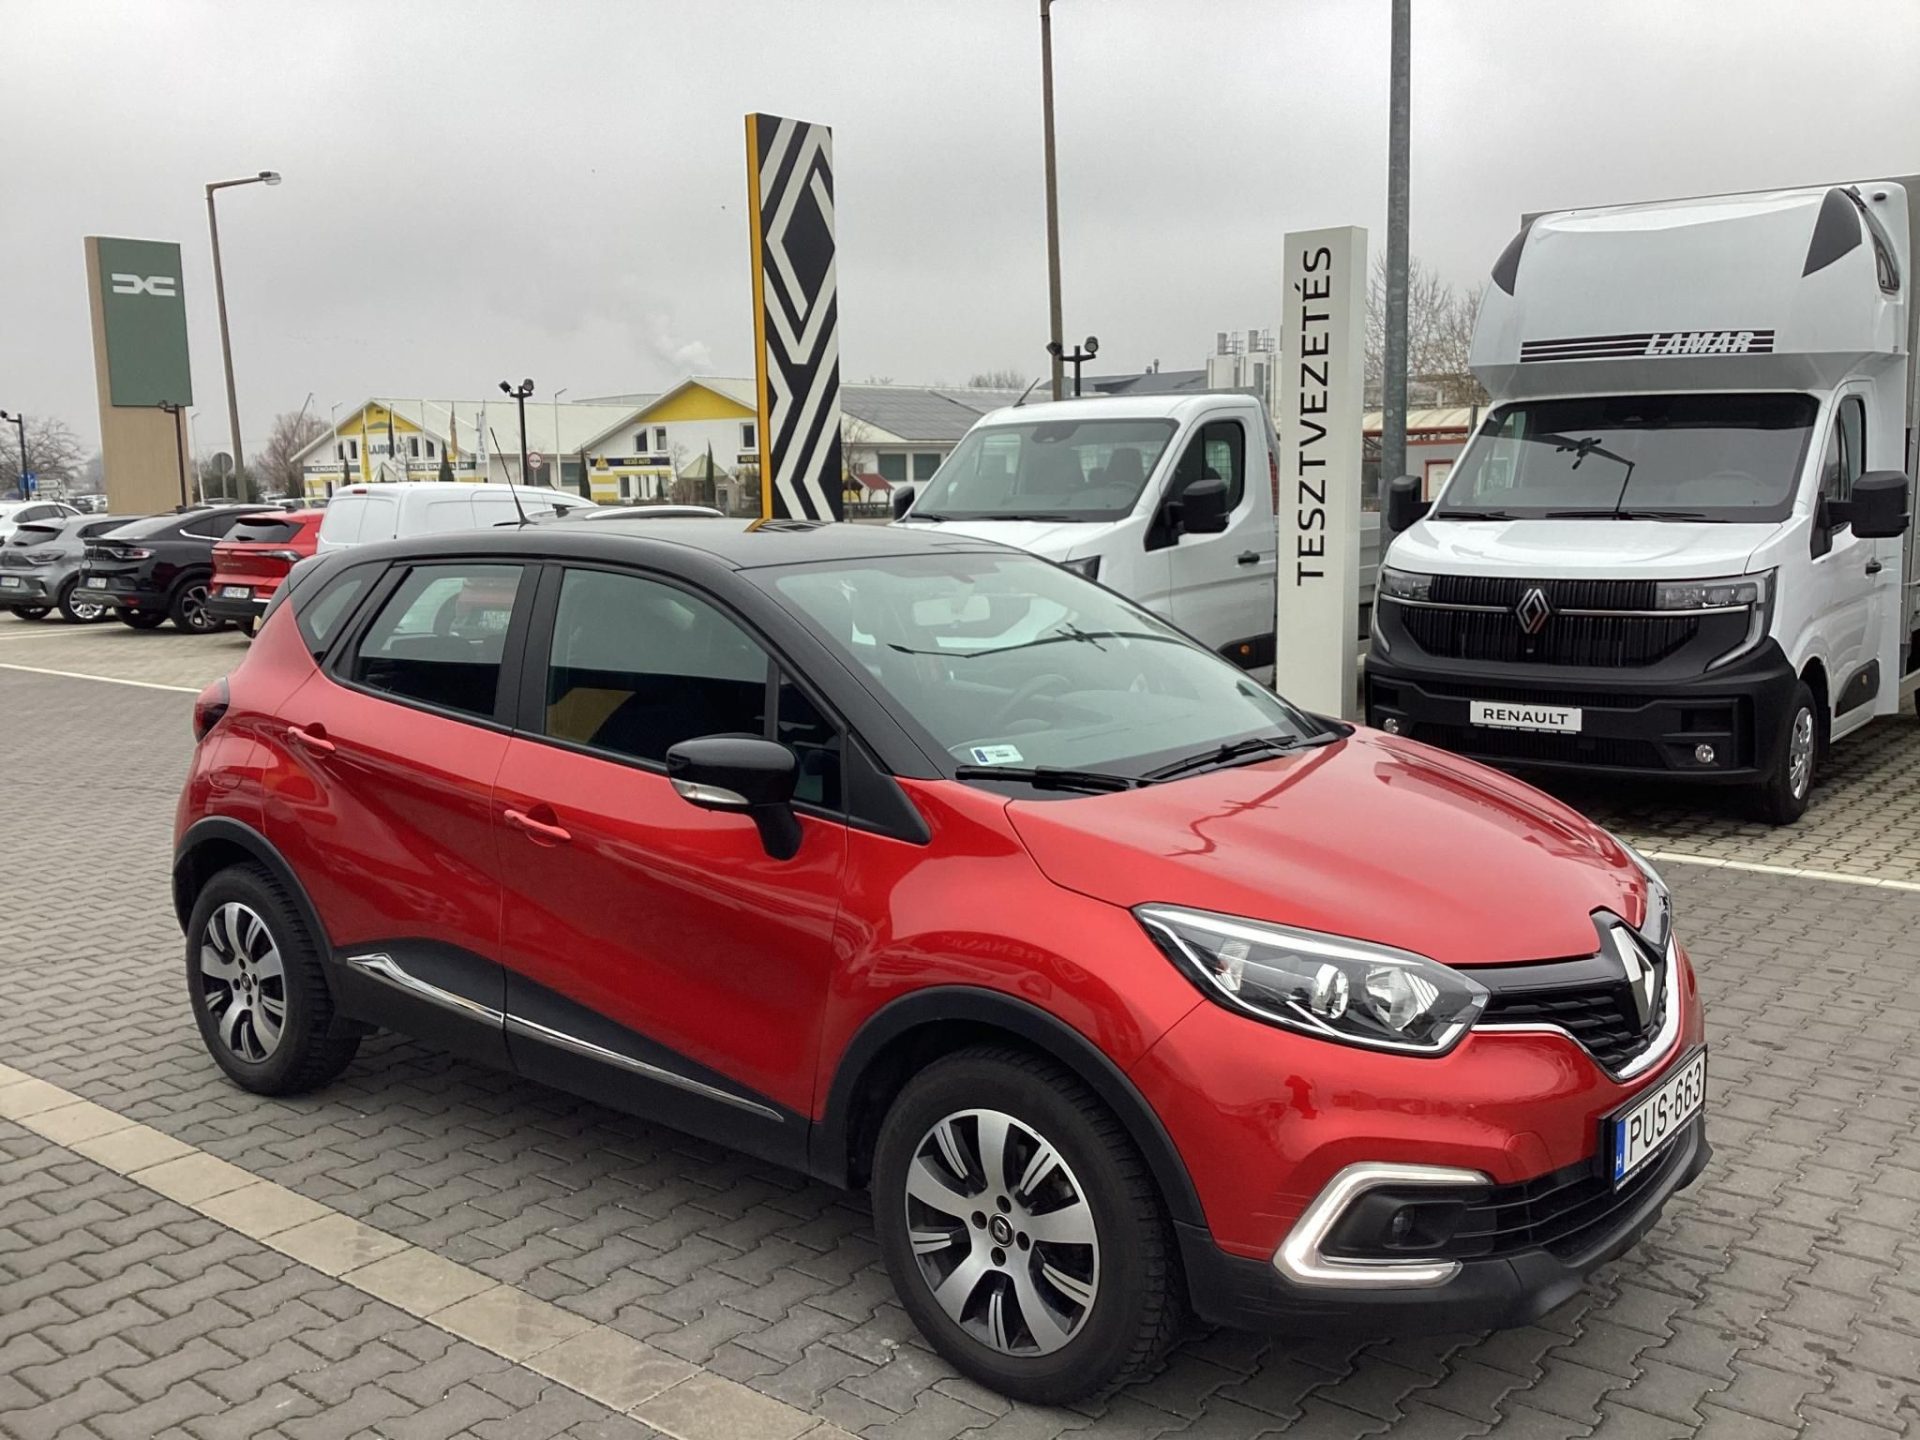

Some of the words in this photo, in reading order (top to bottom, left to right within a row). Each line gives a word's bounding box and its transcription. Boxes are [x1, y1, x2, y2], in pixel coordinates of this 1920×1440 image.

[1644, 331, 1755, 355] LAMAR
[1294, 246, 1332, 586] TESZTVEZETÉS
[1483, 708, 1569, 725] RENAULT
[1615, 1153, 1623, 1171] H
[1629, 1061, 1701, 1163] PUS-663
